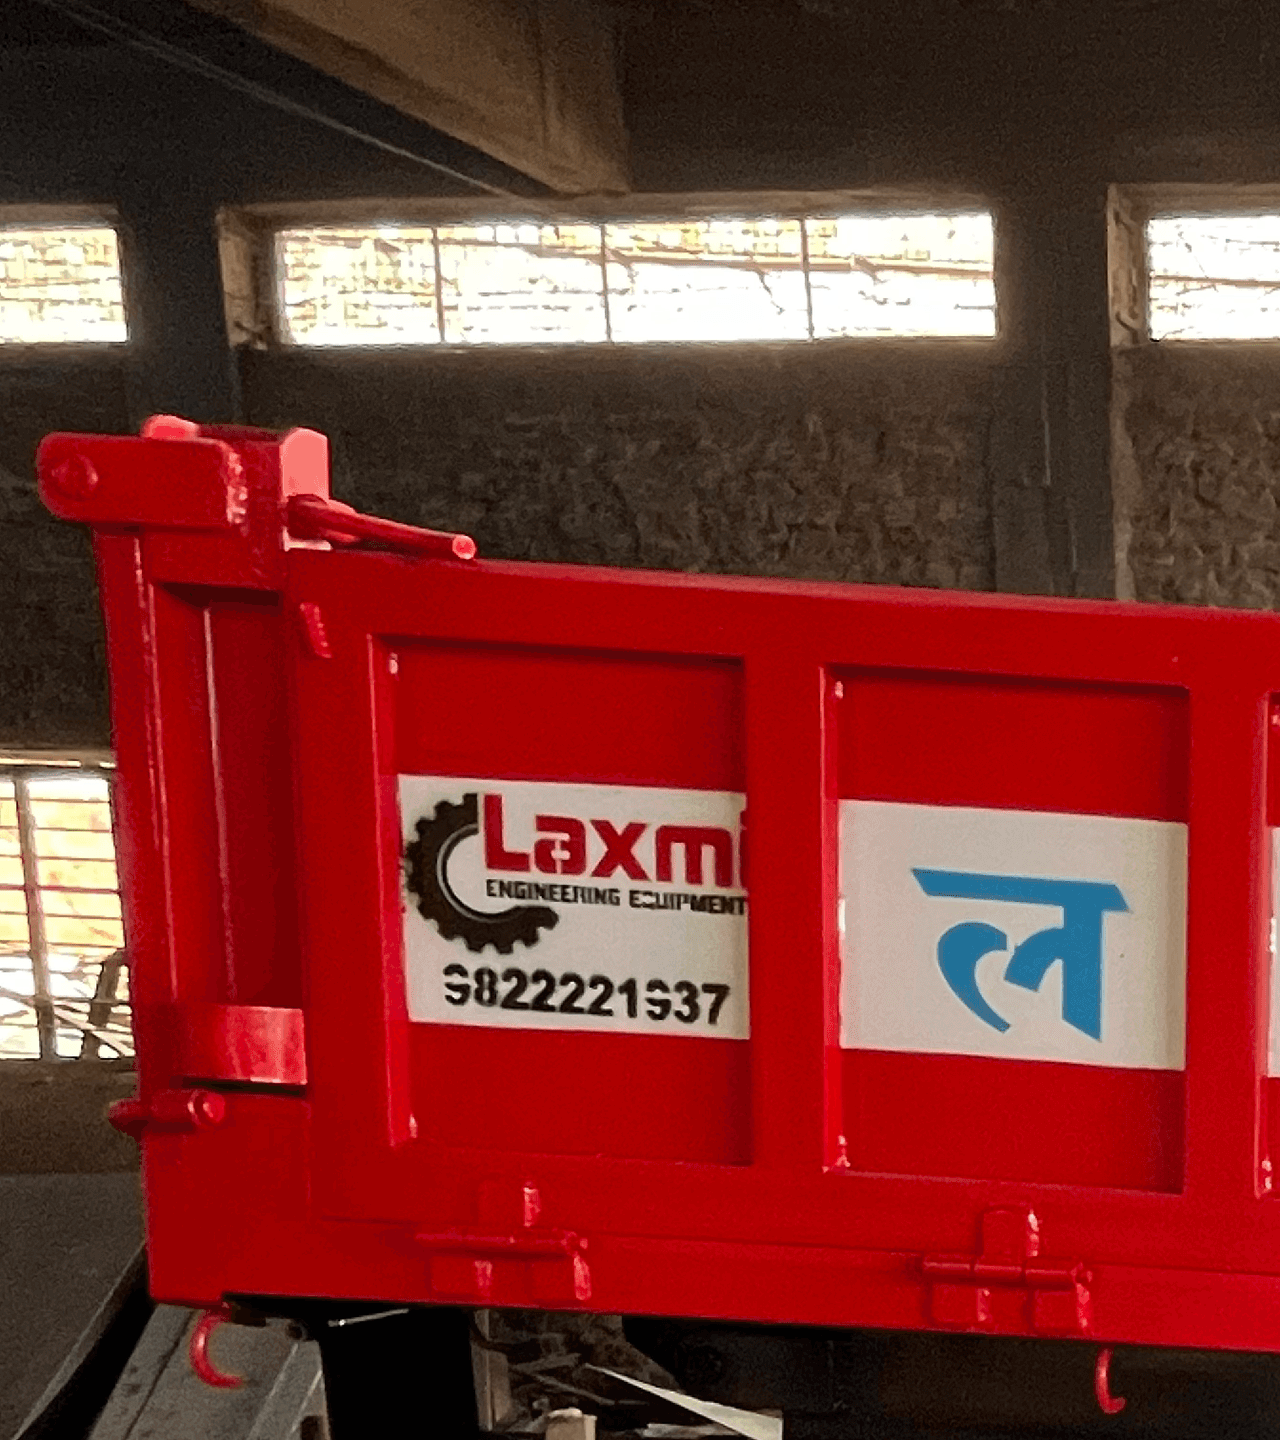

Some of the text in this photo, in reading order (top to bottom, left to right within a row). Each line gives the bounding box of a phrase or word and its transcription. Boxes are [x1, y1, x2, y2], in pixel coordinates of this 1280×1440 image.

[486, 878, 745, 916] ENGINEERING EQUIPMENT
[443, 963, 731, 1026] 9822221937
